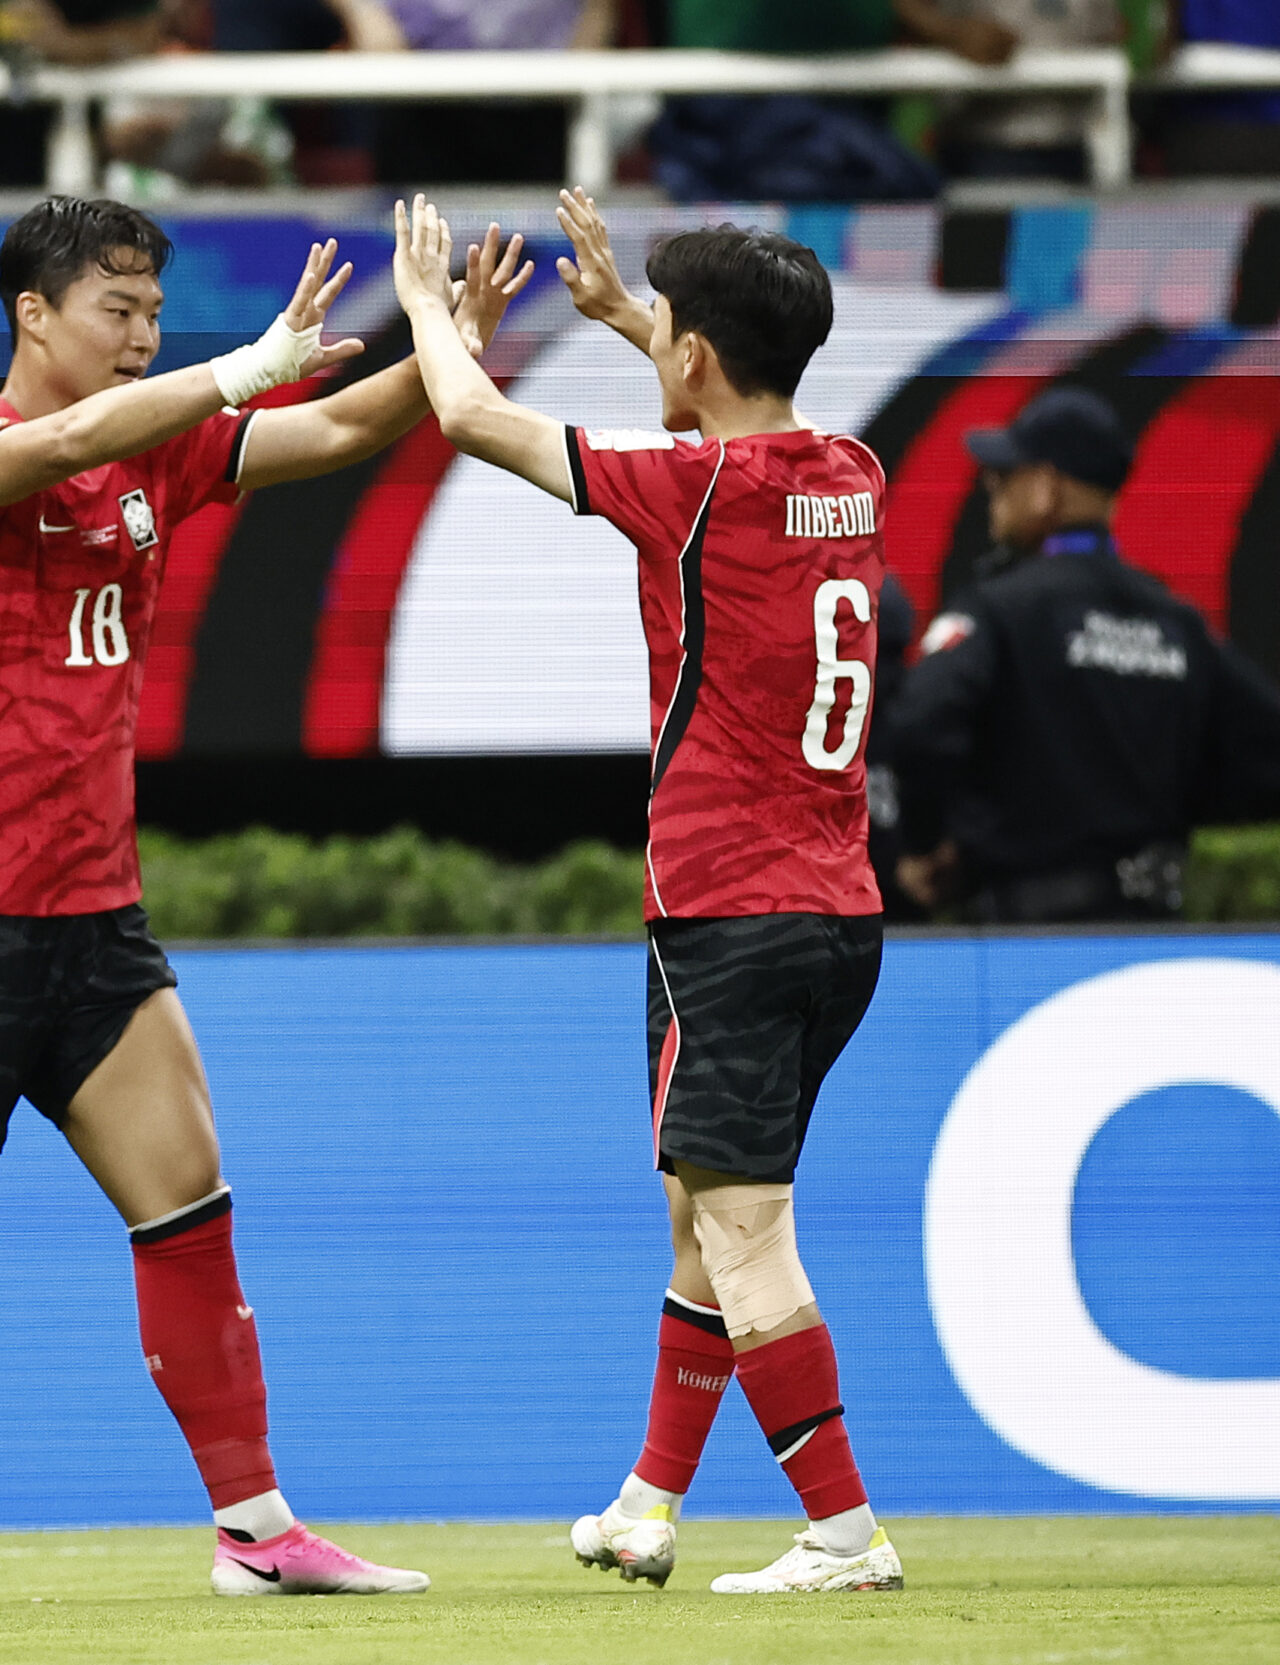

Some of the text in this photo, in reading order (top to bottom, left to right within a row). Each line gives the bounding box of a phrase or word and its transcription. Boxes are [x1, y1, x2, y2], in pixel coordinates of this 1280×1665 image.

[785, 492, 876, 538] INBEOM
[65, 583, 130, 667] 18
[801, 579, 870, 770] 6
